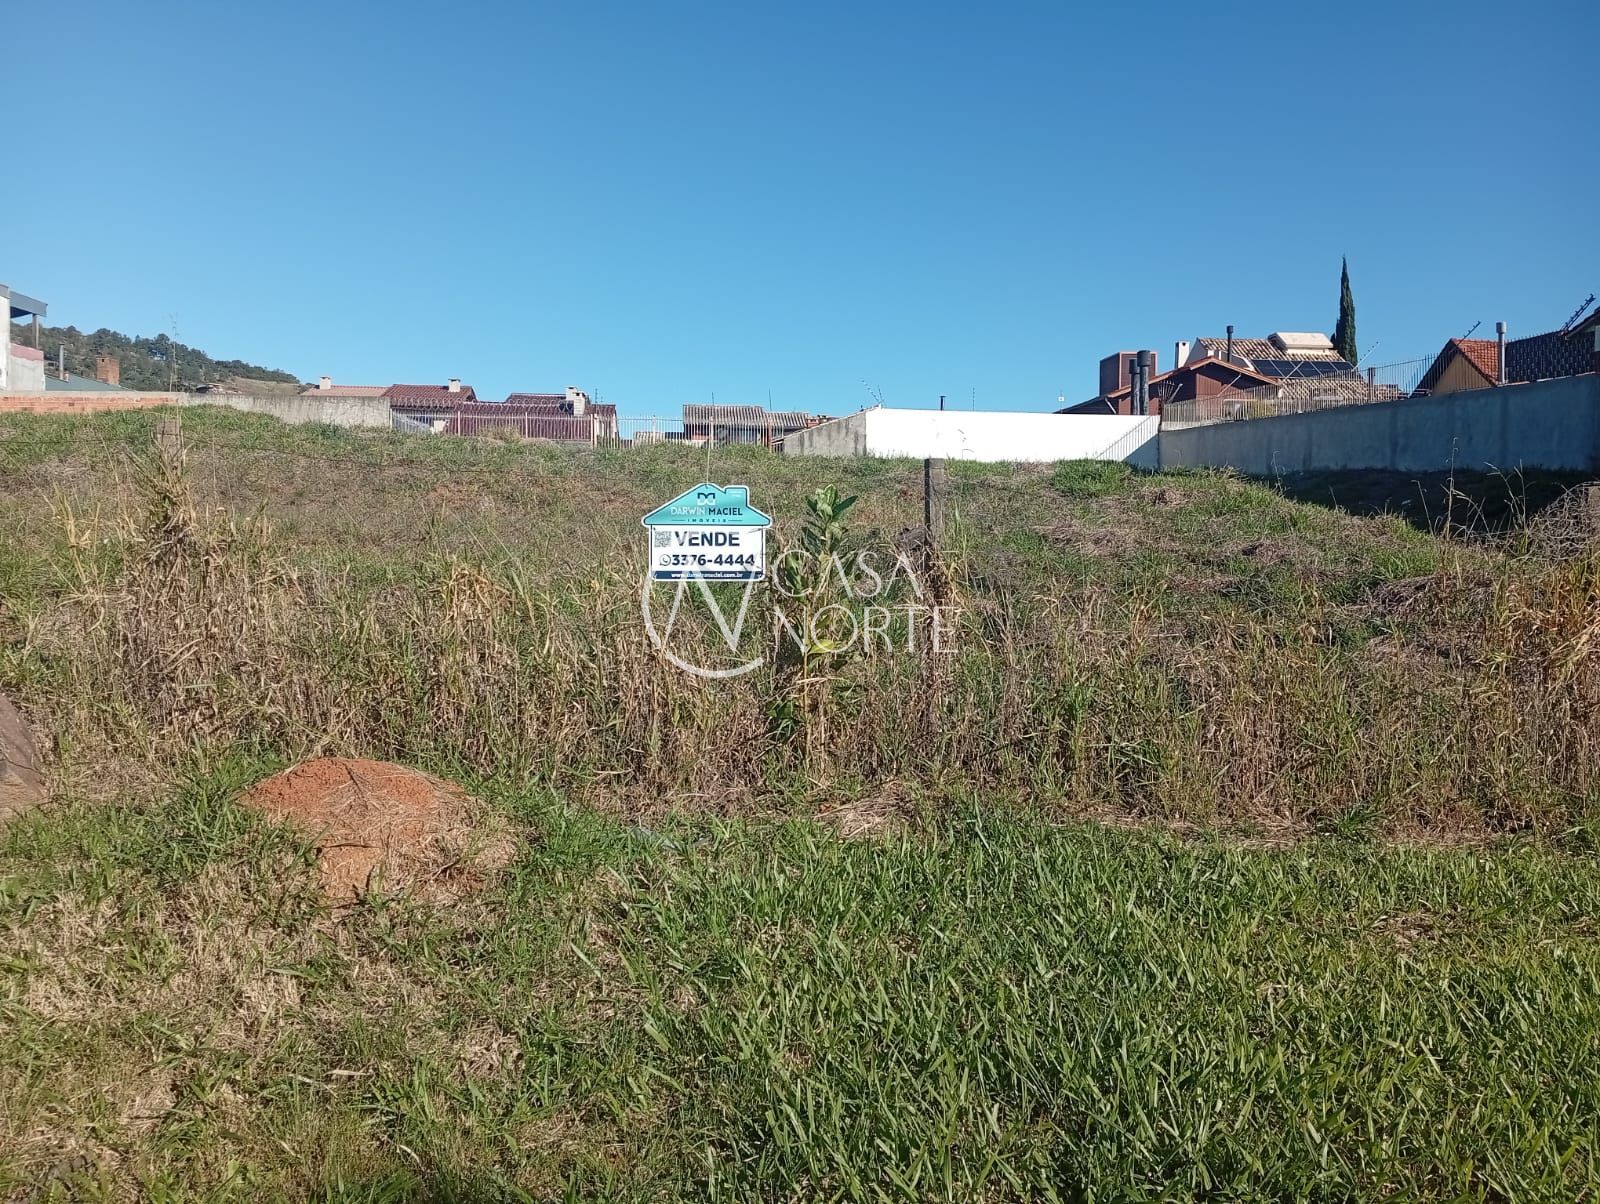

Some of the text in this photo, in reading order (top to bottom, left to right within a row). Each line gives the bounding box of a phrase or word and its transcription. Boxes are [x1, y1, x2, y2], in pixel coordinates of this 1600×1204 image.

[670, 507, 743, 516] DARWIN MACIEL
[674, 531, 740, 547] VENDE
[671, 554, 755, 566] 3376-4444
